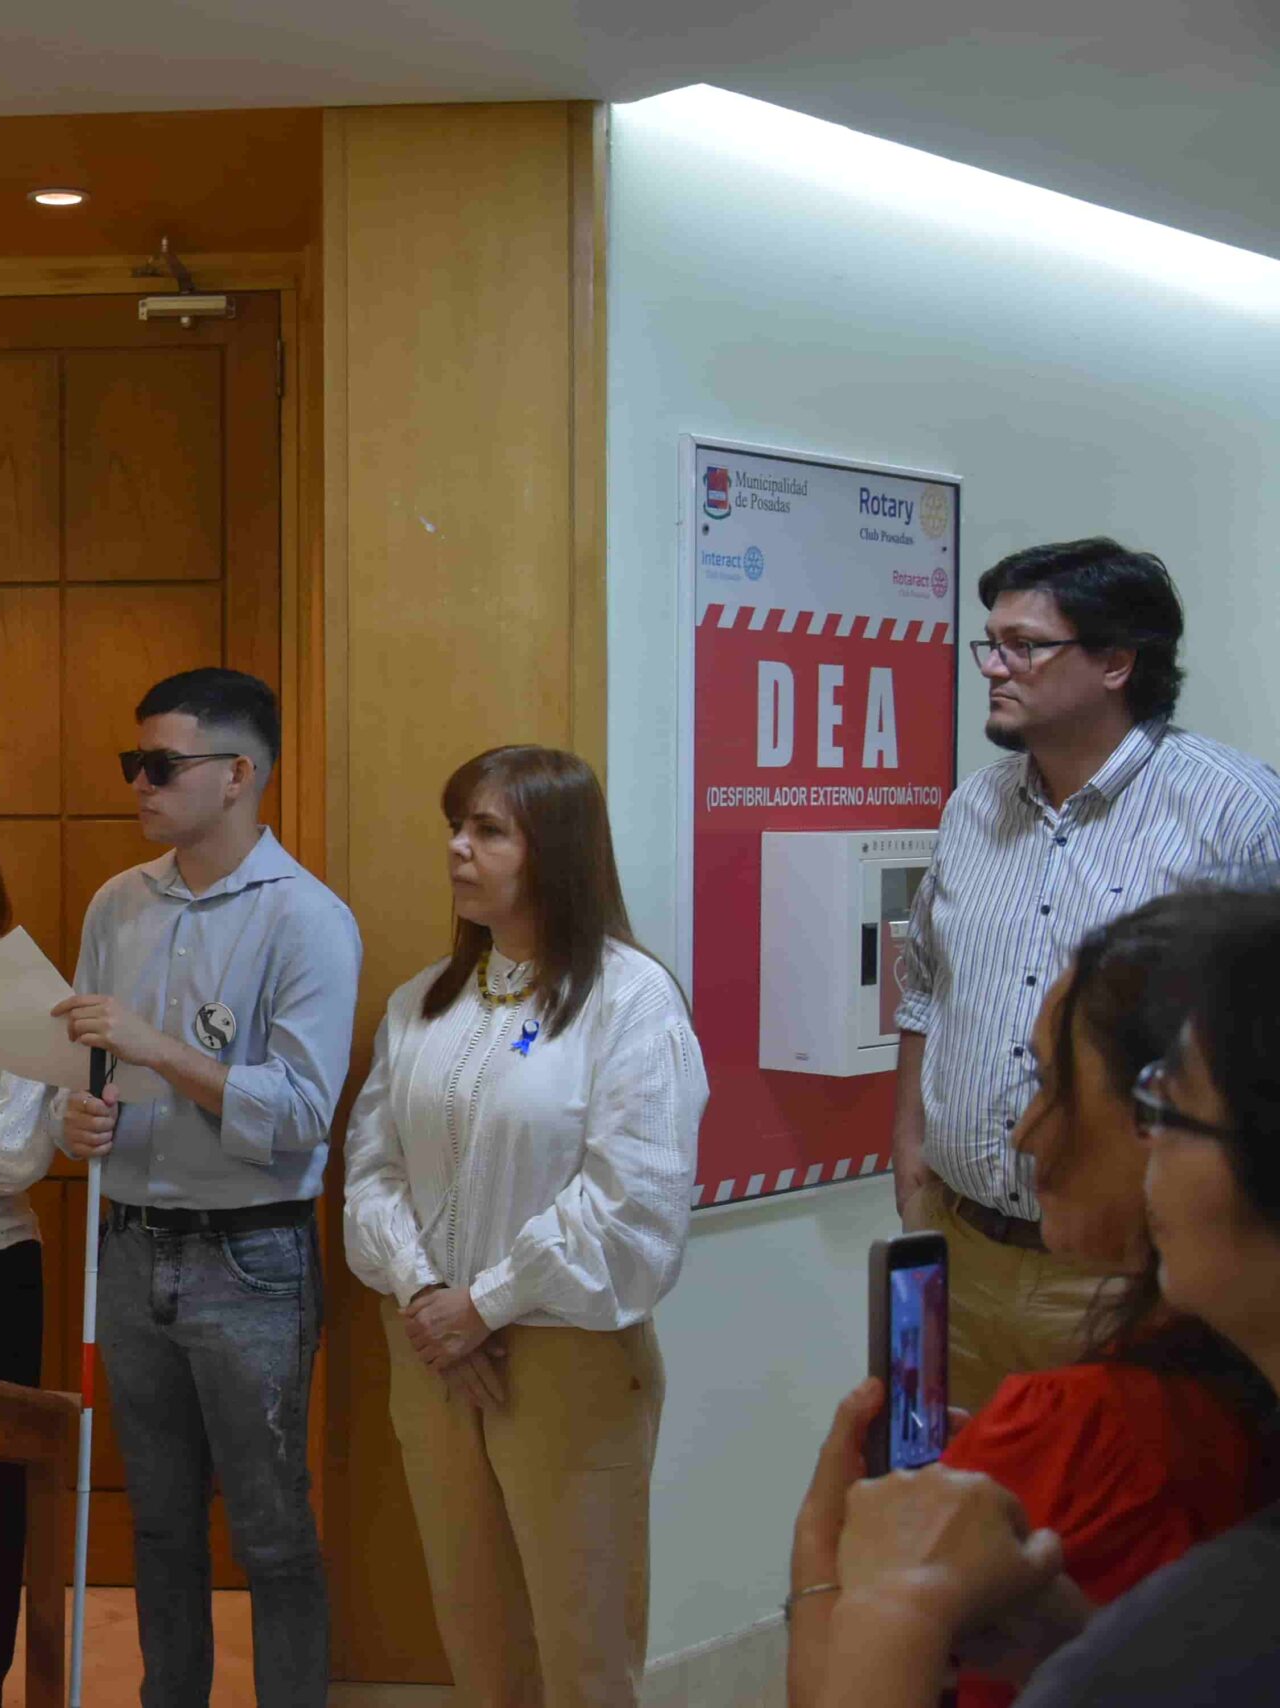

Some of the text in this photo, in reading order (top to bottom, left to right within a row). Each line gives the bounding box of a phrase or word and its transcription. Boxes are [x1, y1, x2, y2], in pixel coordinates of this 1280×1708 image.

[735, 470, 808, 496] Municipalidad
[735, 491, 791, 514] de Posadas
[860, 487, 914, 525] Rotary
[860, 527, 914, 545] Club Posadas
[701, 549, 742, 569] Interact
[893, 570, 929, 588] Rotaract
[706, 782, 942, 812] (DESFIBRILADOR EXTERNO AUTOMÁTICO)
